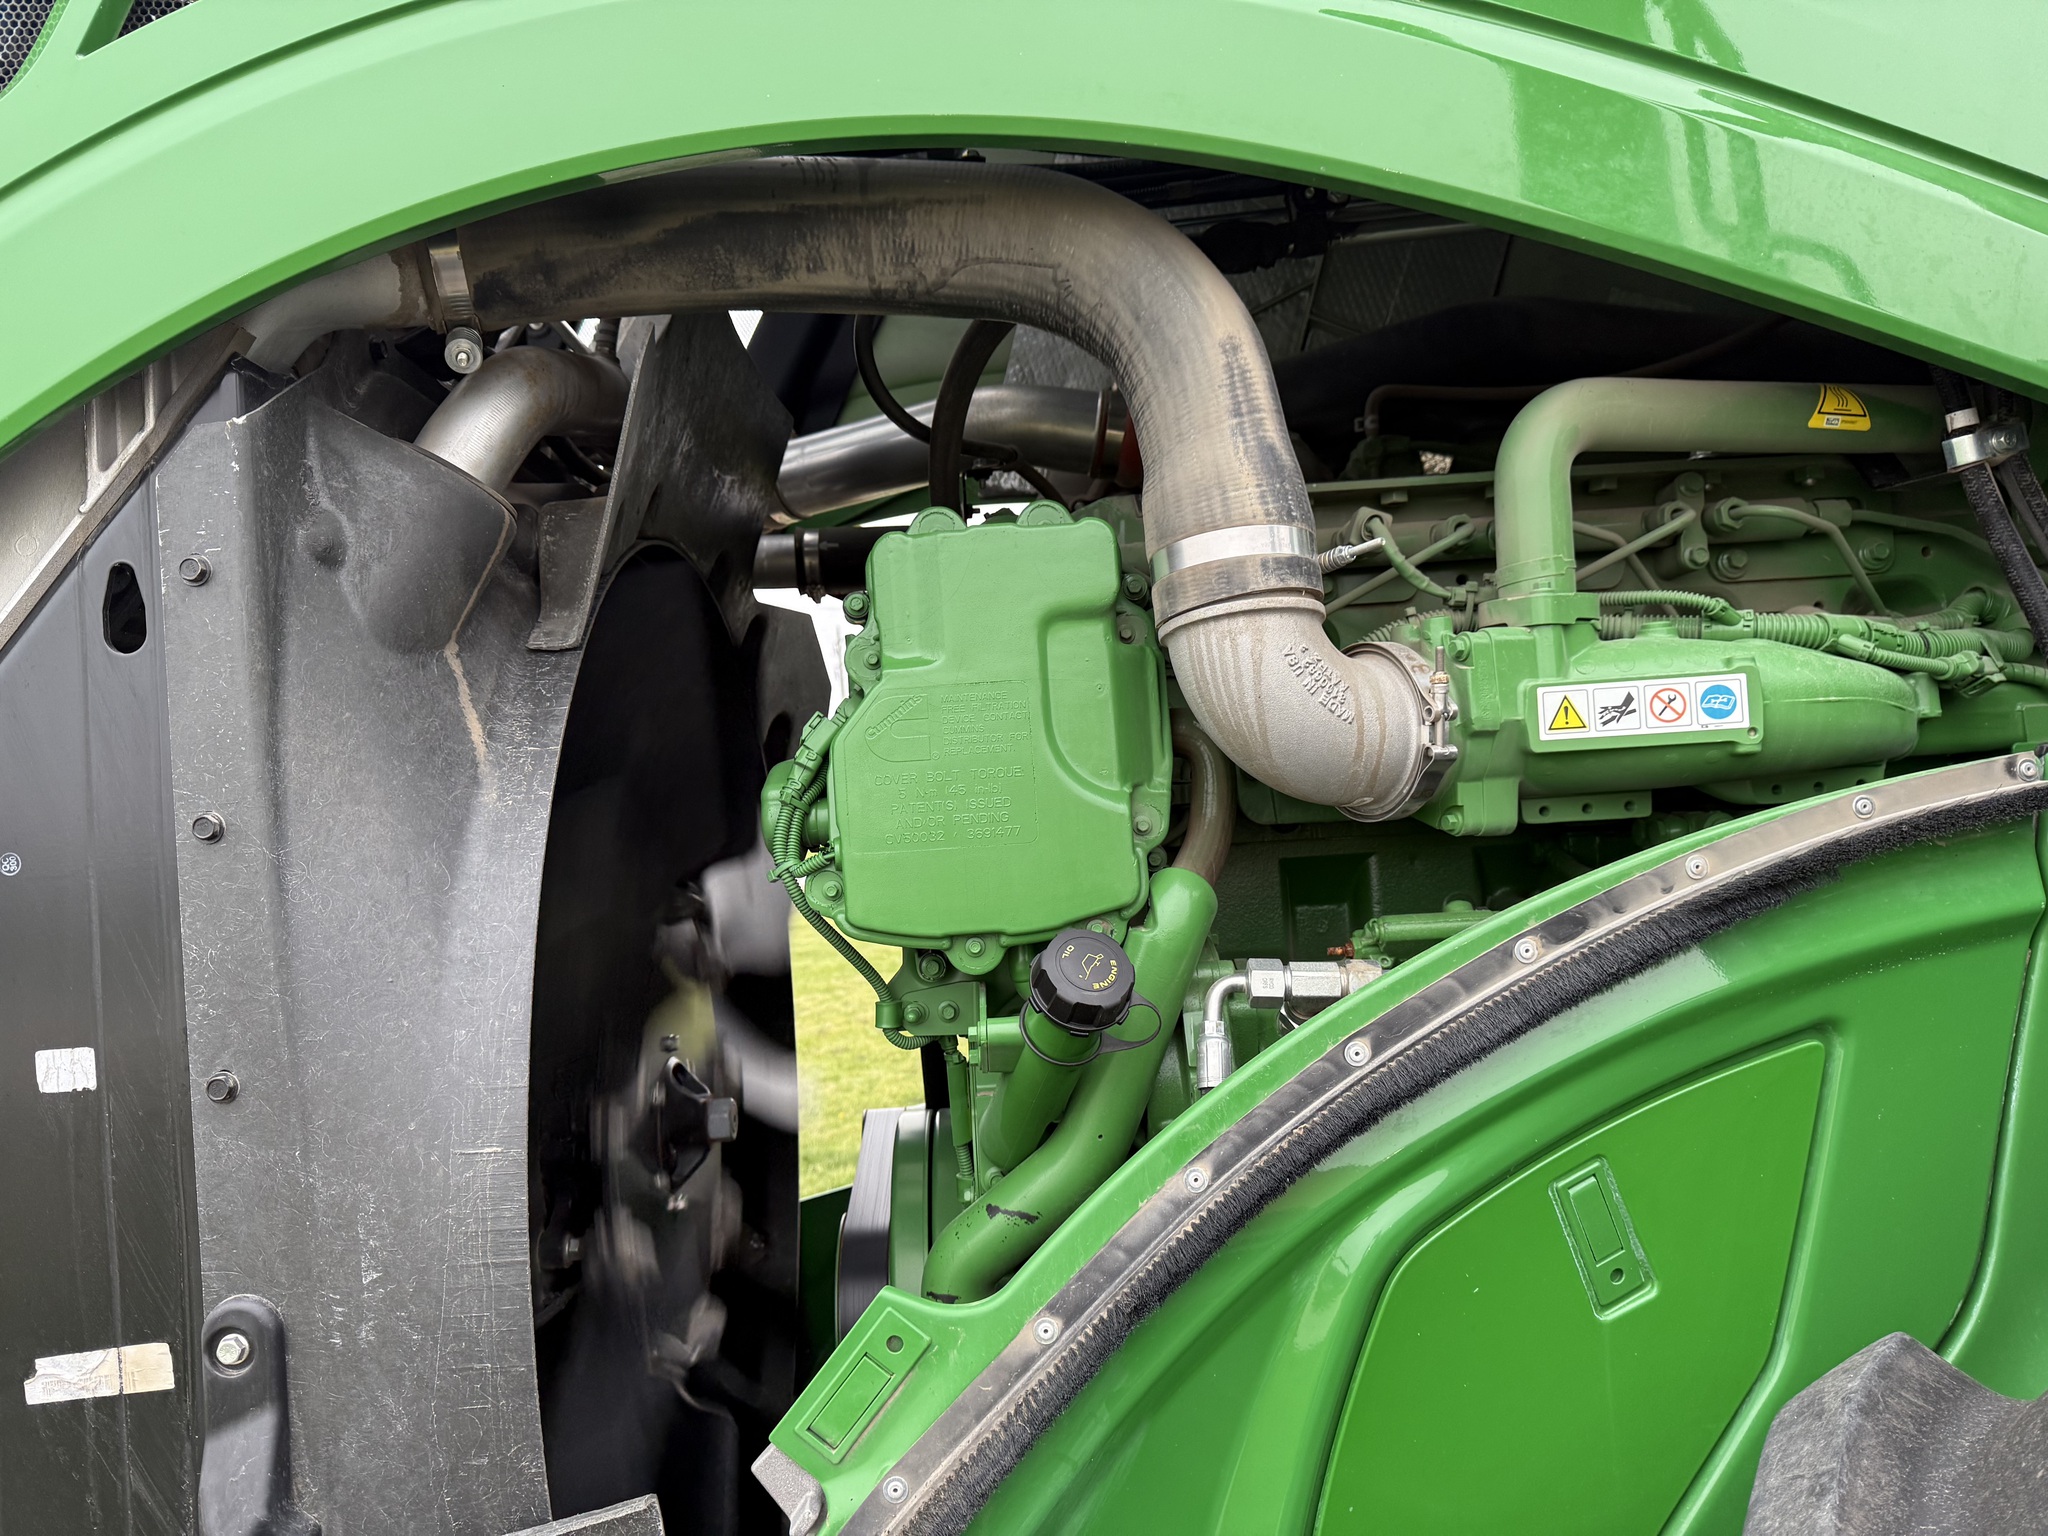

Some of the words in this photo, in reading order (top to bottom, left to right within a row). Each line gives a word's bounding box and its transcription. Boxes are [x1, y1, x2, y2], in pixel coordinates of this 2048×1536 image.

[1302, 676, 1320, 696] IN
[941, 691, 1008, 703] MAINTENANCE
[941, 704, 966, 714] FREE
[971, 700, 1027, 712] FILTRATION
[865, 695, 923, 739] Cummins
[942, 714, 976, 725] DEVICE
[983, 710, 1028, 722] CONTACT
[943, 723, 985, 735] CUMMINS
[943, 733, 1004, 746] DISTRIBUTOR
[1009, 731, 1028, 741] FOR
[944, 743, 1016, 757] REPLACEMENT.
[874, 772, 918, 786] COVER
[926, 769, 960, 783] BOLT
[898, 788, 907, 799] 5
[891, 799, 957, 815] PATENT(S)
[965, 796, 1012, 811] ISSUED
[896, 815, 946, 830] AND/OR
[953, 811, 1010, 826] PENDING
[885, 830, 946, 845] CV50032
[966, 825, 1022, 840] 3691477
[1061, 944, 1075, 959] OIL
[1092, 959, 1118, 990] ENGINE
